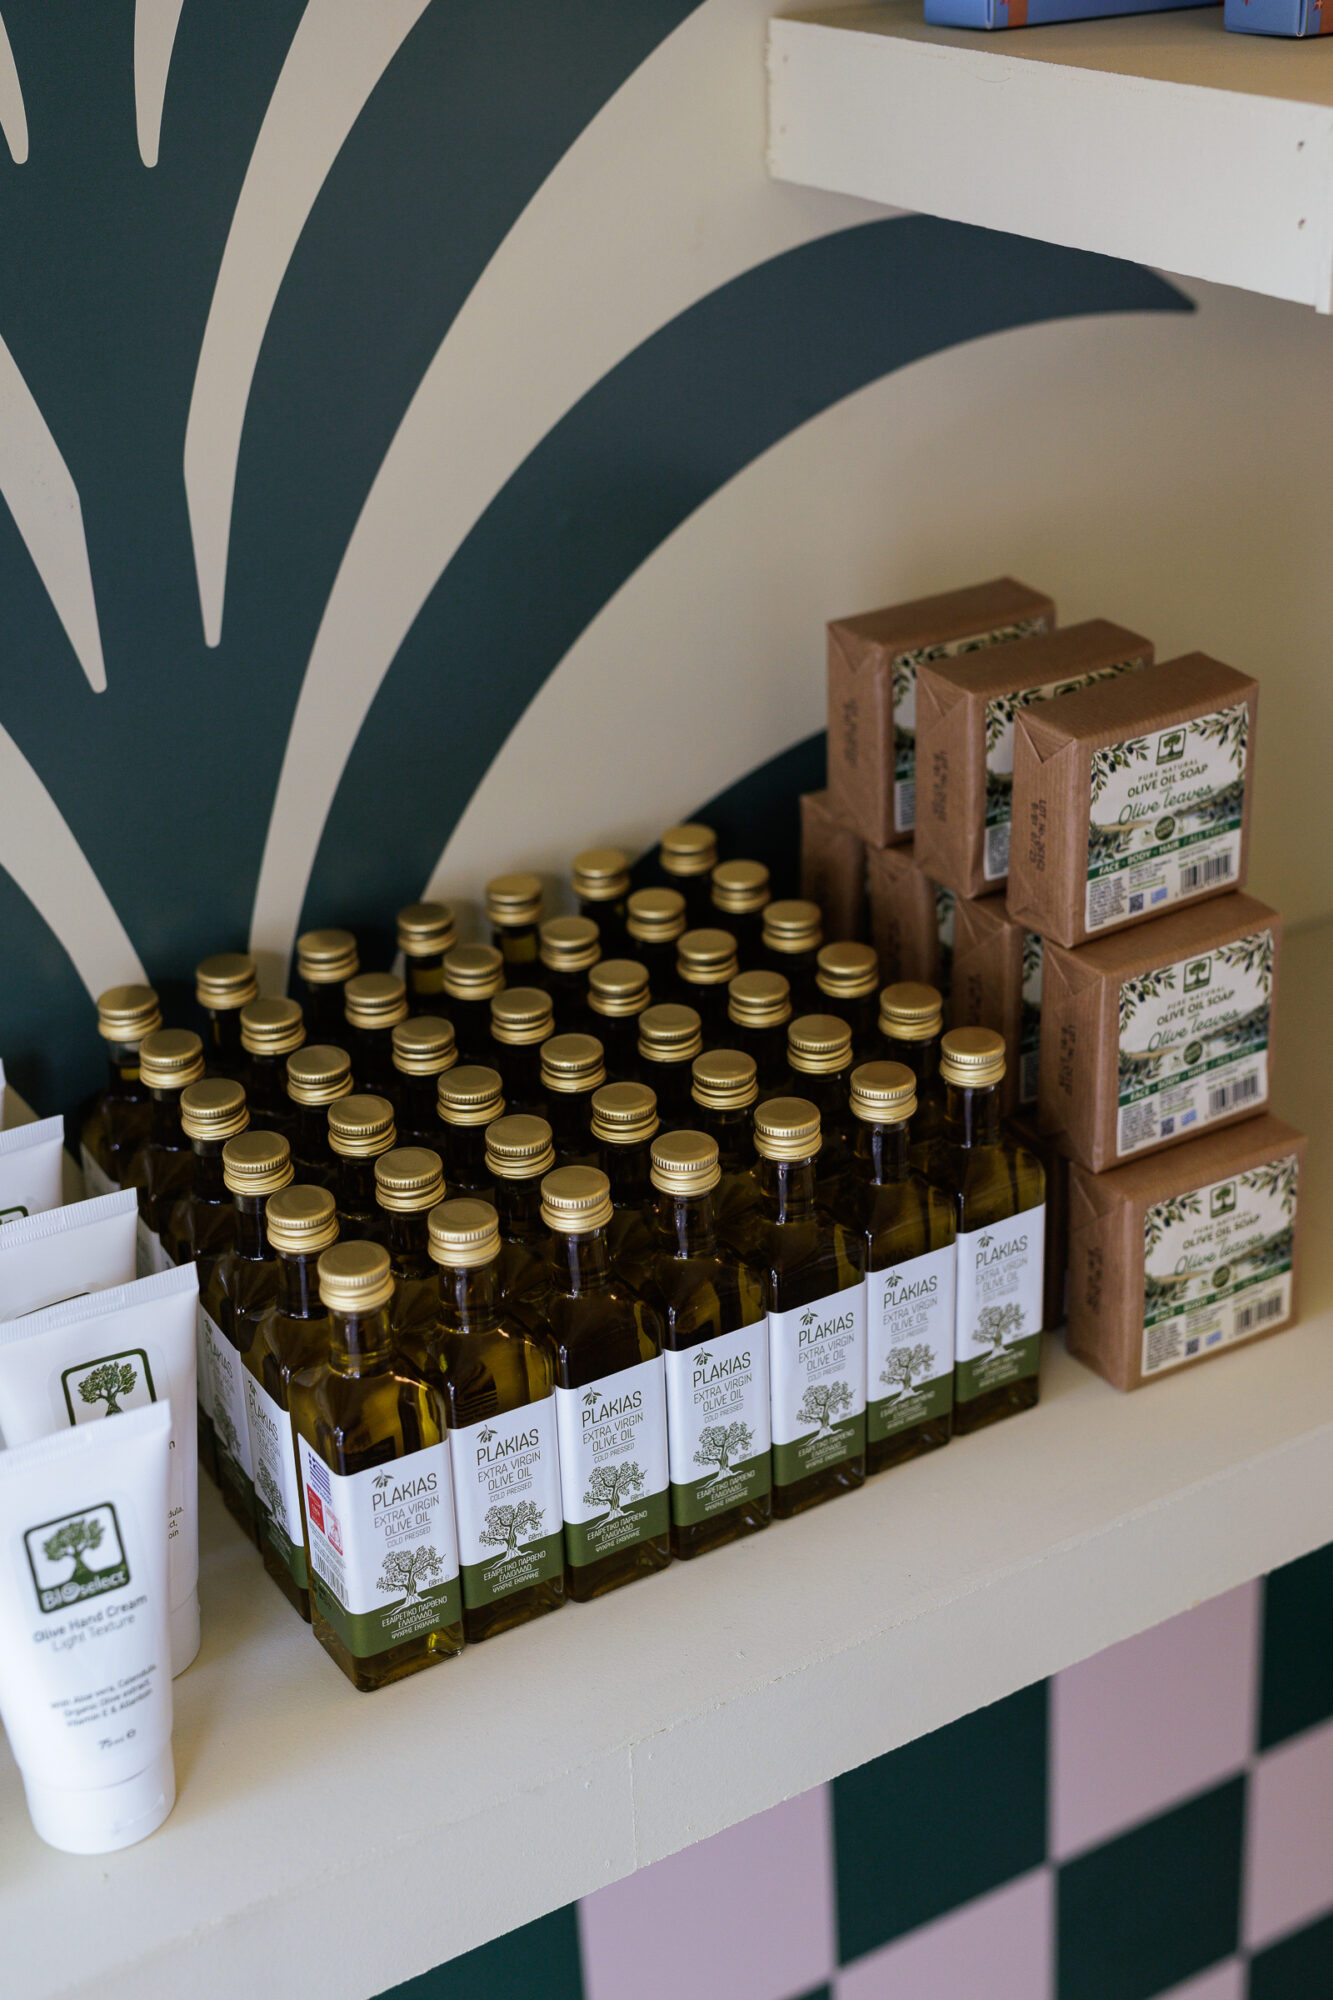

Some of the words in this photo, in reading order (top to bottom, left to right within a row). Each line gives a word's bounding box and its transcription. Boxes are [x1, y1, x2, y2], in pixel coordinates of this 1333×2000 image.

[1127, 778, 1158, 798] OLIVE
[1160, 773, 1177, 787] OIL
[1180, 762, 1209, 782] SOAP
[1118, 800, 1160, 826] Olive
[1156, 1006, 1185, 1026] OLIVE
[975, 1234, 1028, 1270] PLAKIAS
[883, 1275, 938, 1310] PLAKIAS
[882, 1307, 909, 1326] EXTRA
[911, 1296, 938, 1314] VIRGIN
[798, 1311, 854, 1348] PLAKIAS
[798, 1345, 826, 1364] EXTRA
[827, 1333, 855, 1351] VIRGIN
[806, 1353, 831, 1372] OLIVE
[832, 1348, 846, 1361] OIL
[693, 1351, 751, 1388] PLAKIAS
[693, 1385, 722, 1405] EXTRA
[724, 1372, 752, 1392] VIRGIN
[702, 1393, 728, 1413] OLIVE
[730, 1388, 744, 1402] OIL
[581, 1390, 642, 1429] PLAKIAS
[582, 1425, 612, 1445] EXTRA
[614, 1411, 644, 1431] VIRGIN
[592, 1433, 618, 1453] OLIVE
[620, 1427, 635, 1442] OIL
[476, 1428, 539, 1467] PLAKIAS
[478, 1463, 508, 1484] EXTRA
[510, 1449, 541, 1470] VIRGIN
[488, 1472, 515, 1491] OLIVE
[517, 1466, 533, 1480] OIL
[372, 1472, 438, 1512] PLAKIAS
[374, 1508, 406, 1529] EXTRA
[408, 1494, 440, 1515] VIRGIN
[384, 1517, 412, 1537] OLIVE
[415, 1511, 431, 1525] OIL
[386, 1537, 404, 1549] COLD
[405, 1526, 431, 1541] PRESSED
[33, 1625, 66, 1643] Olive
[68, 1611, 104, 1631] Hand
[105, 1595, 148, 1618] Cream
[88, 1613, 136, 1639] Texture
